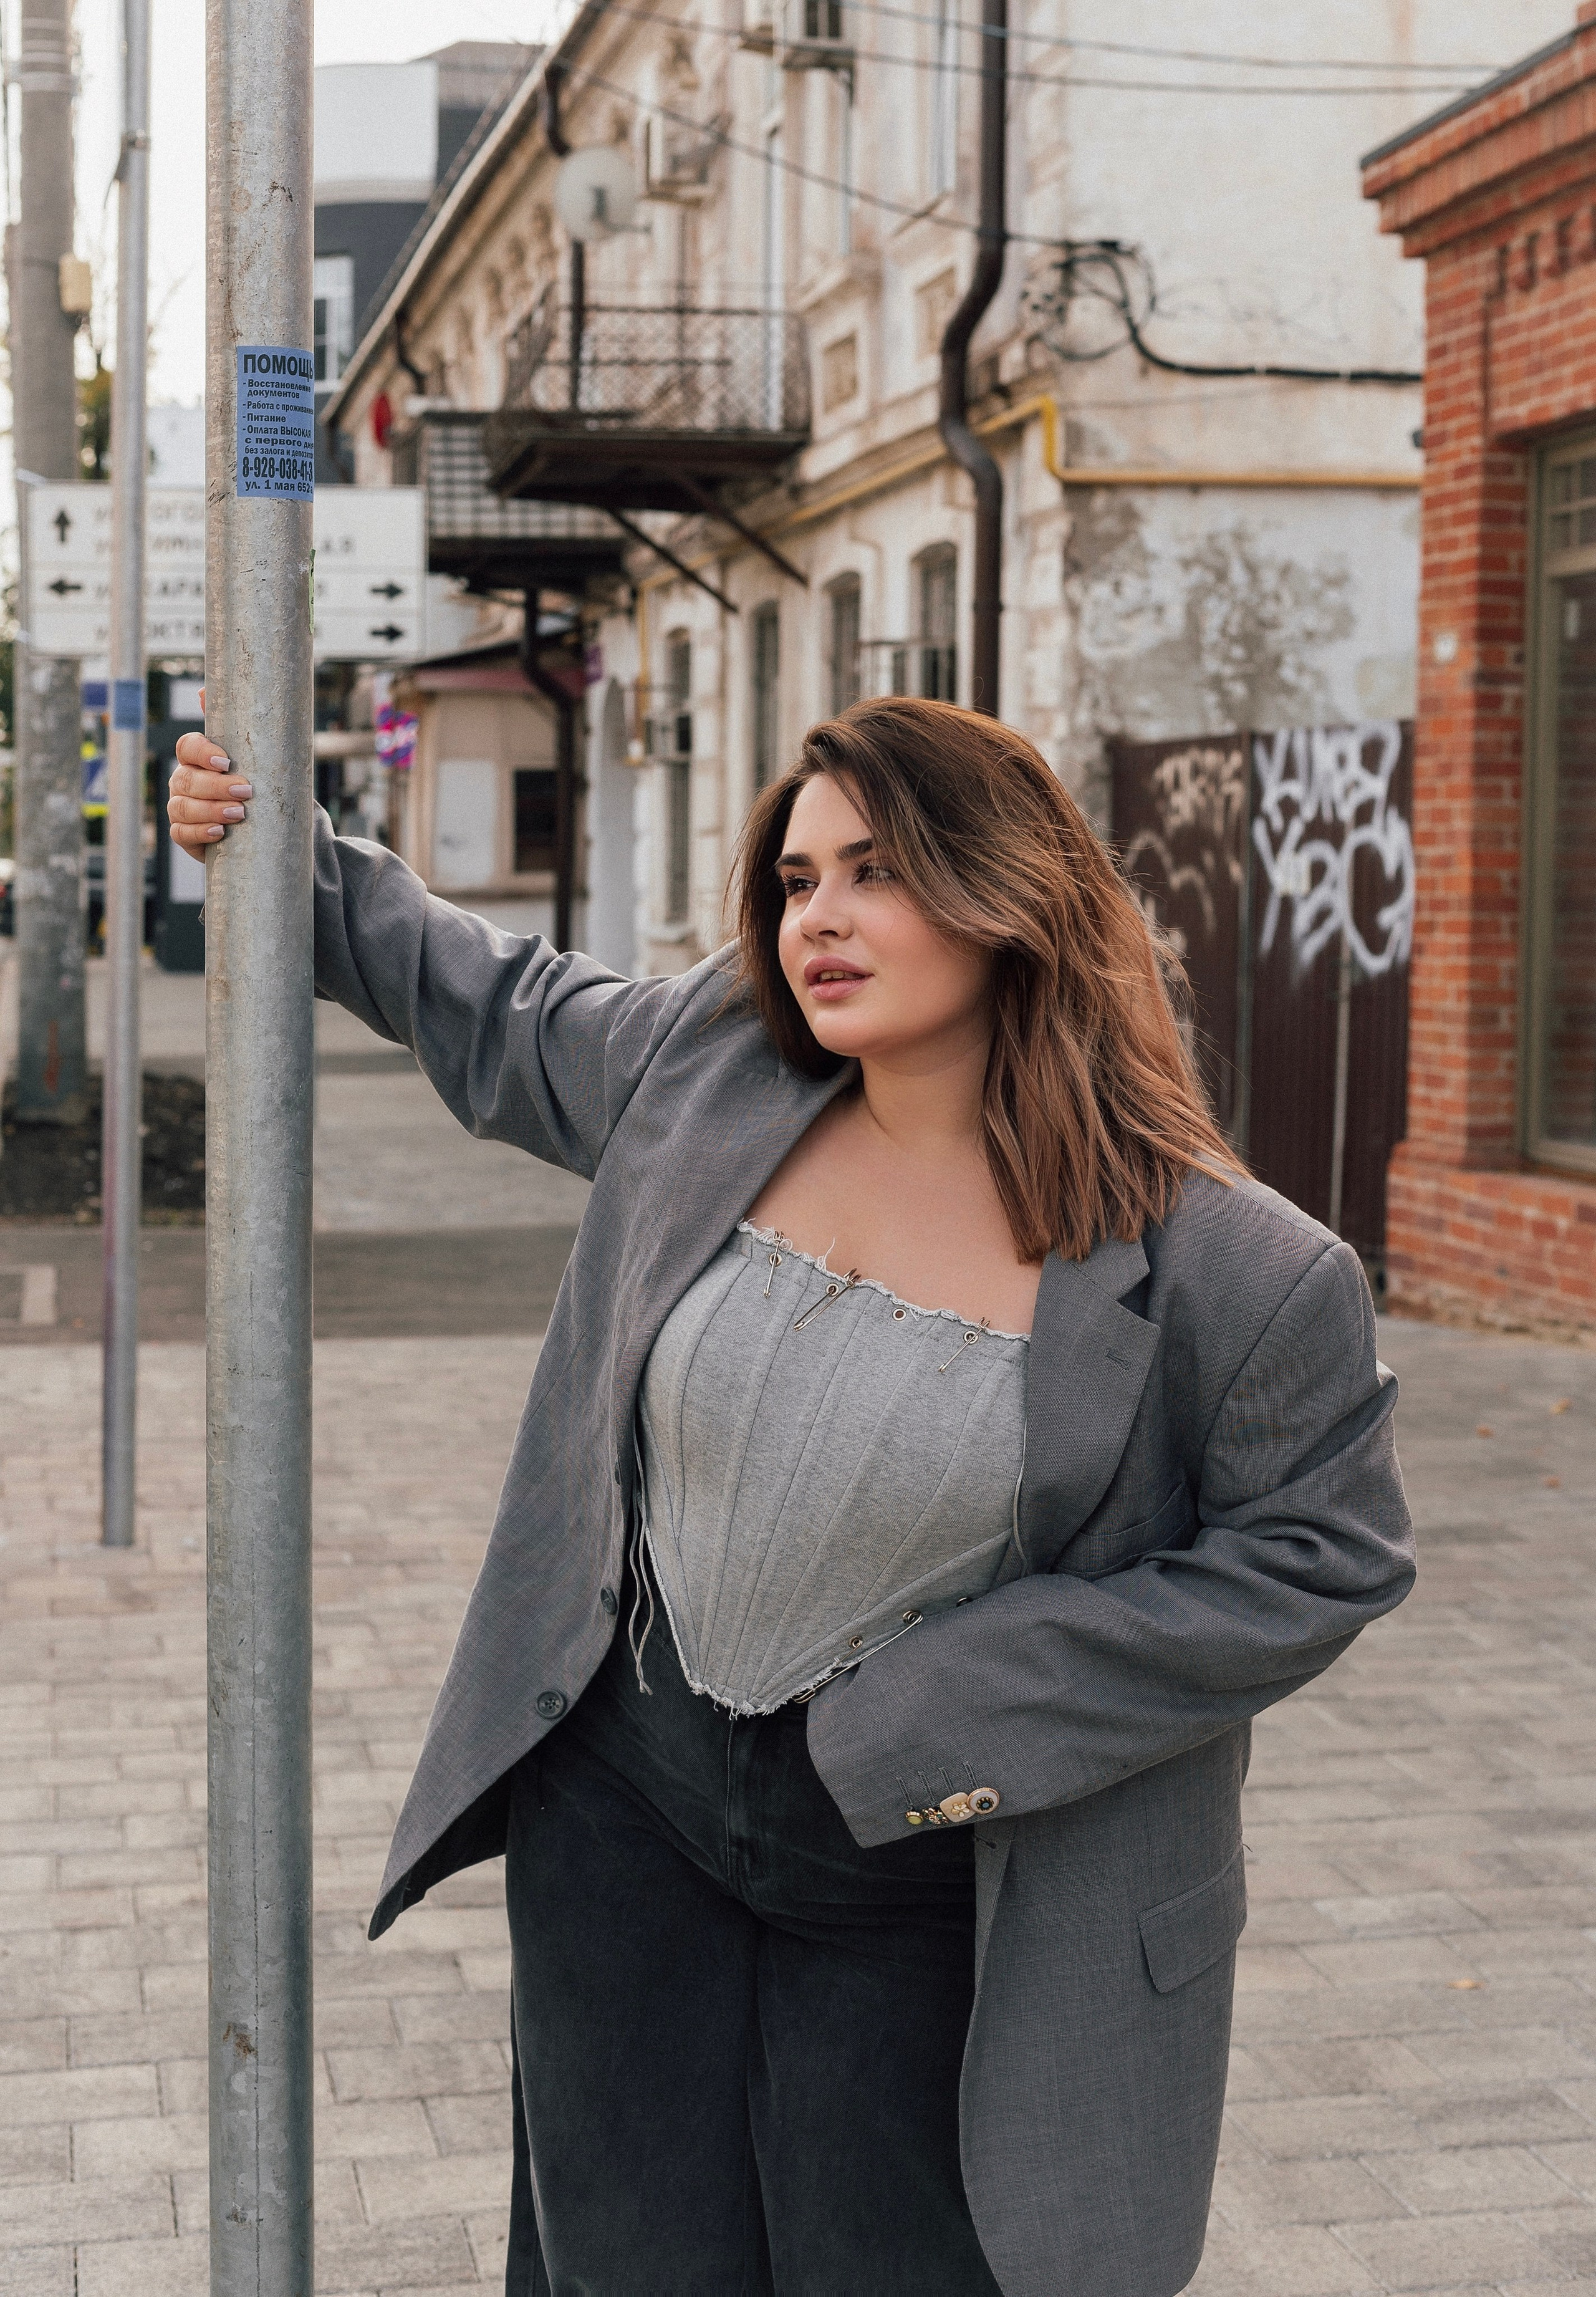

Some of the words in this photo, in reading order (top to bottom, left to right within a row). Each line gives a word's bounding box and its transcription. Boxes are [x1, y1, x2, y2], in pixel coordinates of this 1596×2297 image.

[244, 354, 313, 382] ПОМОЩЬ
[248, 379, 311, 393] Восстановление
[247, 390, 300, 399] документов
[247, 400, 274, 410] Работа
[247, 413, 286, 422] Питание
[247, 425, 278, 435] Оплата
[281, 426, 311, 438] ВЫСОКАЯ
[255, 438, 302, 447] первого
[244, 445, 258, 455] без
[243, 456, 313, 483] 8-928-038-41-3
[245, 481, 261, 491] ул.
[264, 479, 271, 489] 1
[274, 482, 295, 491] мая
